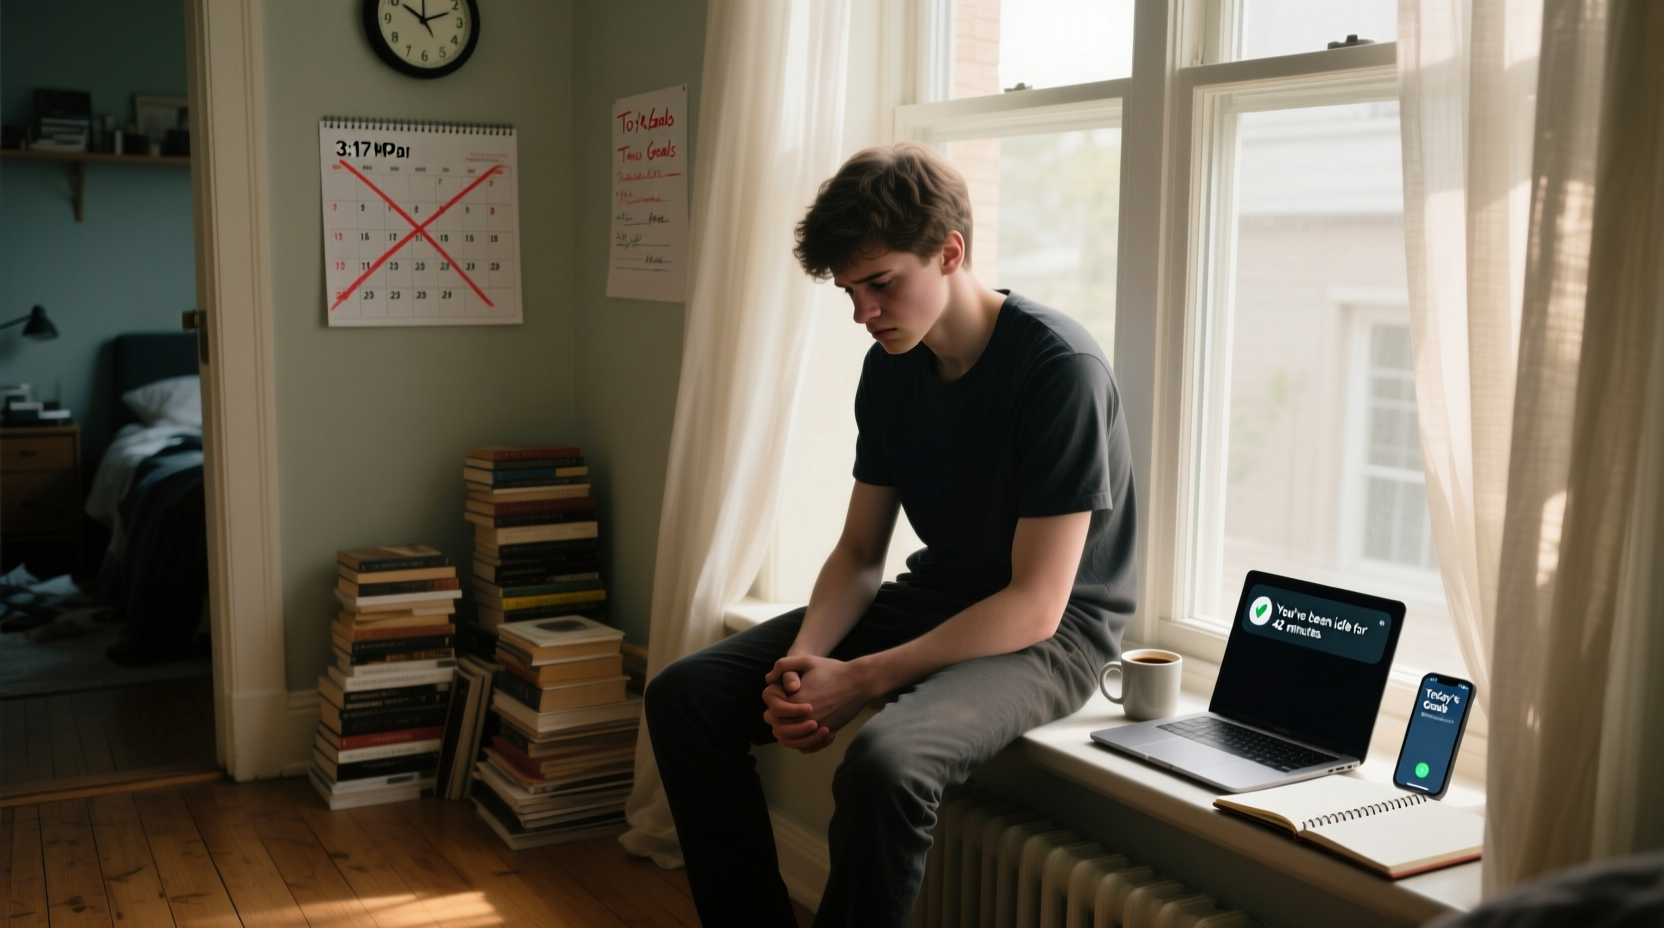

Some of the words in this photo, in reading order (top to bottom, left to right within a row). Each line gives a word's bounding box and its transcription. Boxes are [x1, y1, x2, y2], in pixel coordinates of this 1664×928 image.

[450, 0, 459, 10] 2
[384, 12, 392, 24] 9
[456, 17, 463, 29] 3
[391, 31, 399, 43] 8
[450, 34, 458, 45] 4
[405, 45, 412, 58] 7
[421, 50, 429, 62] 6
[439, 46, 446, 58] 5
[336, 140, 371, 158] 3:17
[1276, 602, 1307, 621] You've
[1308, 610, 1333, 628] been
[1271, 618, 1286, 631] 42
